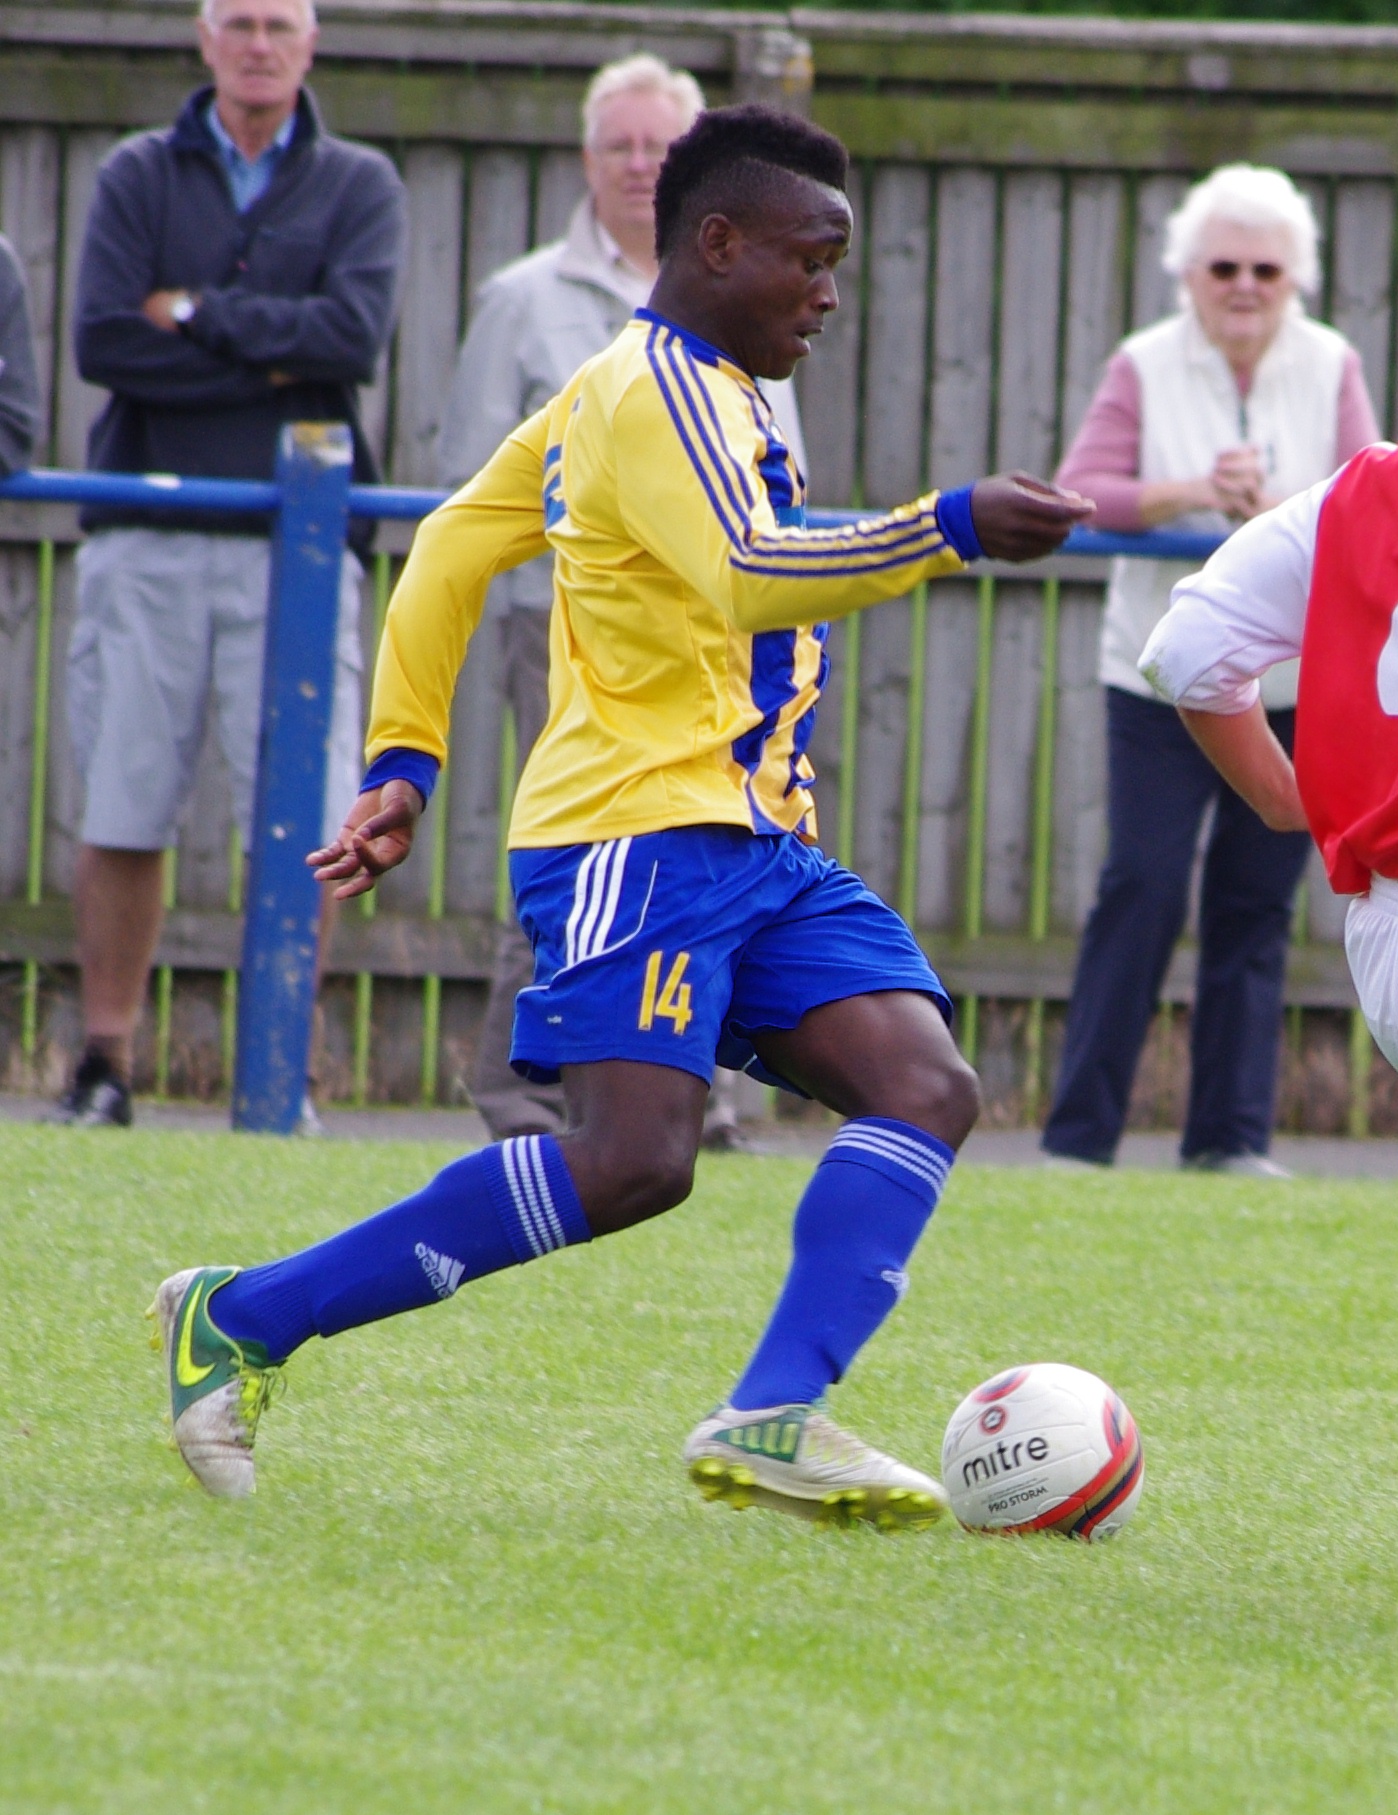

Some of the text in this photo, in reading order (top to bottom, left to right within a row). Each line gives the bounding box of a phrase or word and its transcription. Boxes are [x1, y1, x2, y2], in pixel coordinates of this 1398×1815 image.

[637, 950, 693, 1036] 14
[414, 1241, 455, 1299] adida
[962, 1436, 1048, 1487] mitre
[1009, 1485, 1049, 1507] STORM
